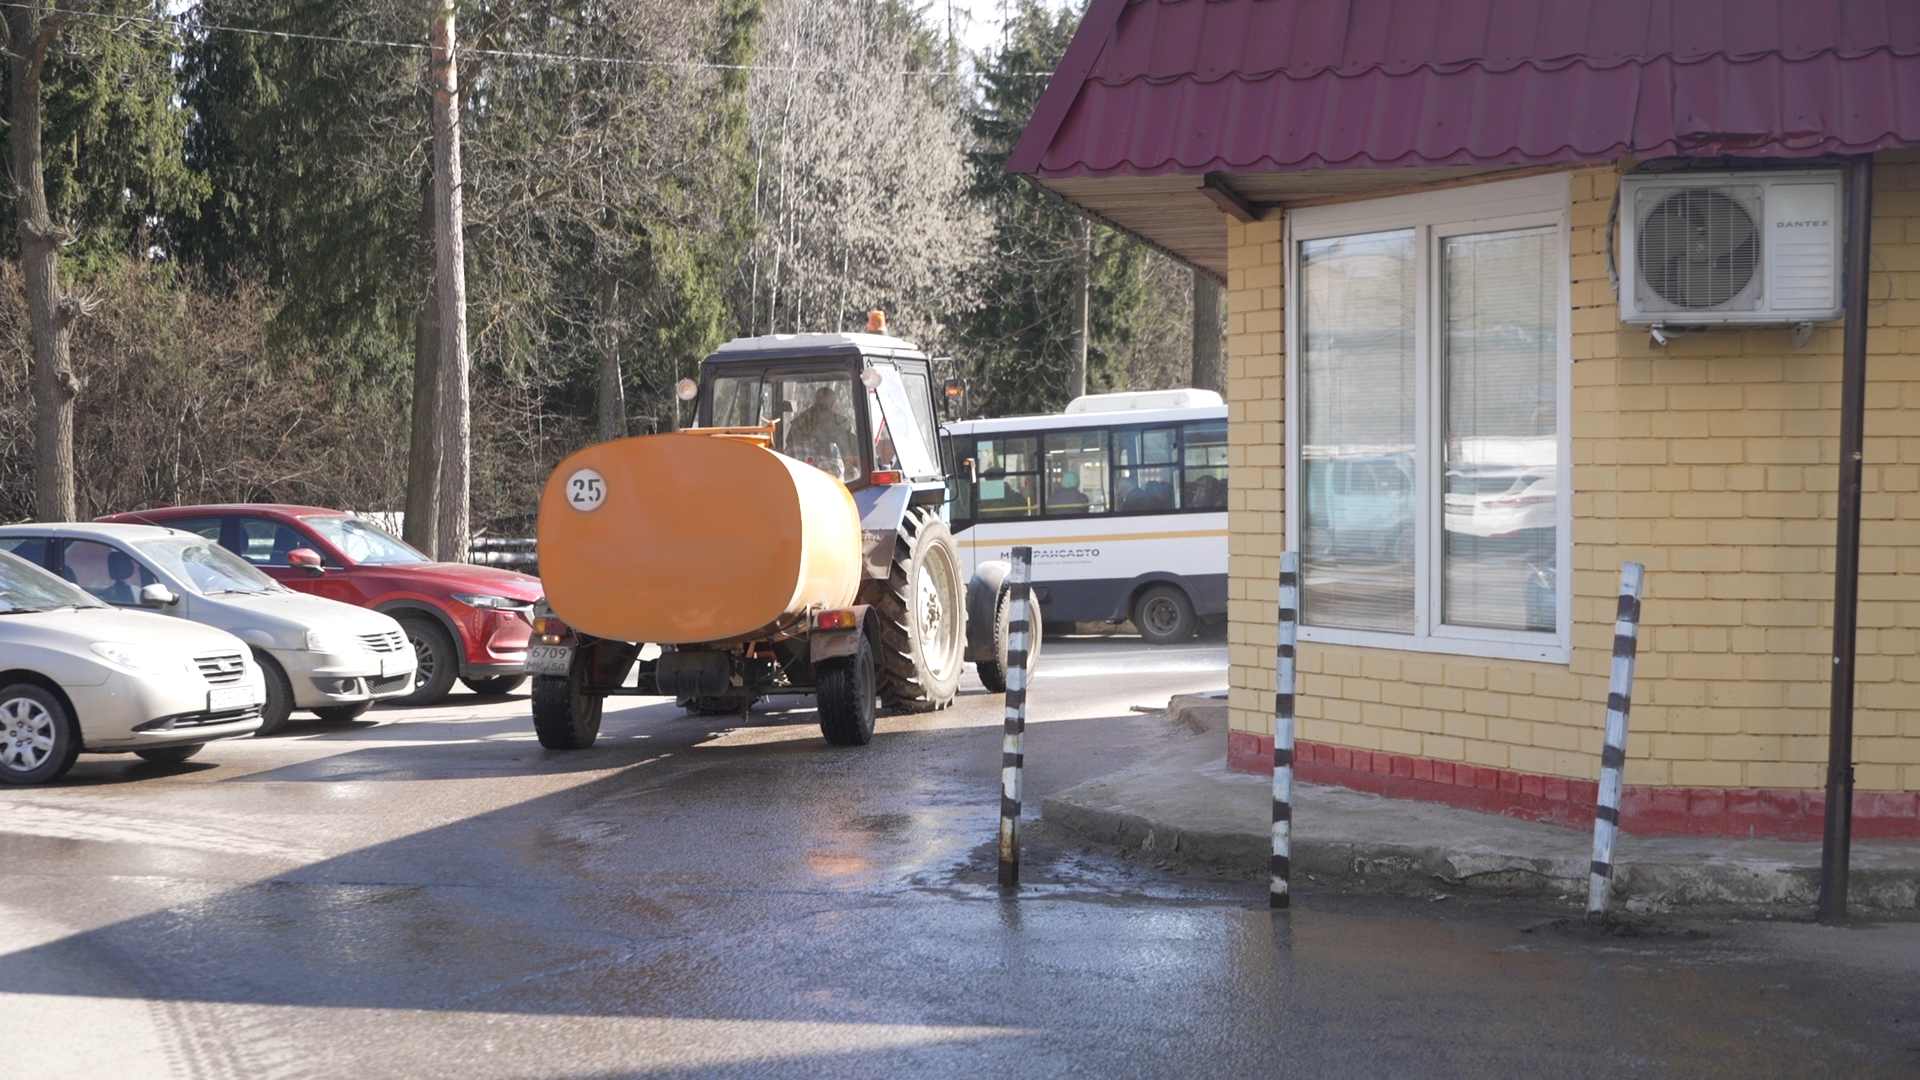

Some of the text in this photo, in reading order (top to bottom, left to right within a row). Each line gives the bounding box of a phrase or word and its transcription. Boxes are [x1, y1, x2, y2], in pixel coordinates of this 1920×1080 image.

[1776, 220, 1829, 228] DANTEX
[573, 478, 602, 502] 25
[1000, 548, 1100, 560] МРАНСАВТО
[532, 647, 567, 659] 6709
[551, 662, 565, 671] 50
